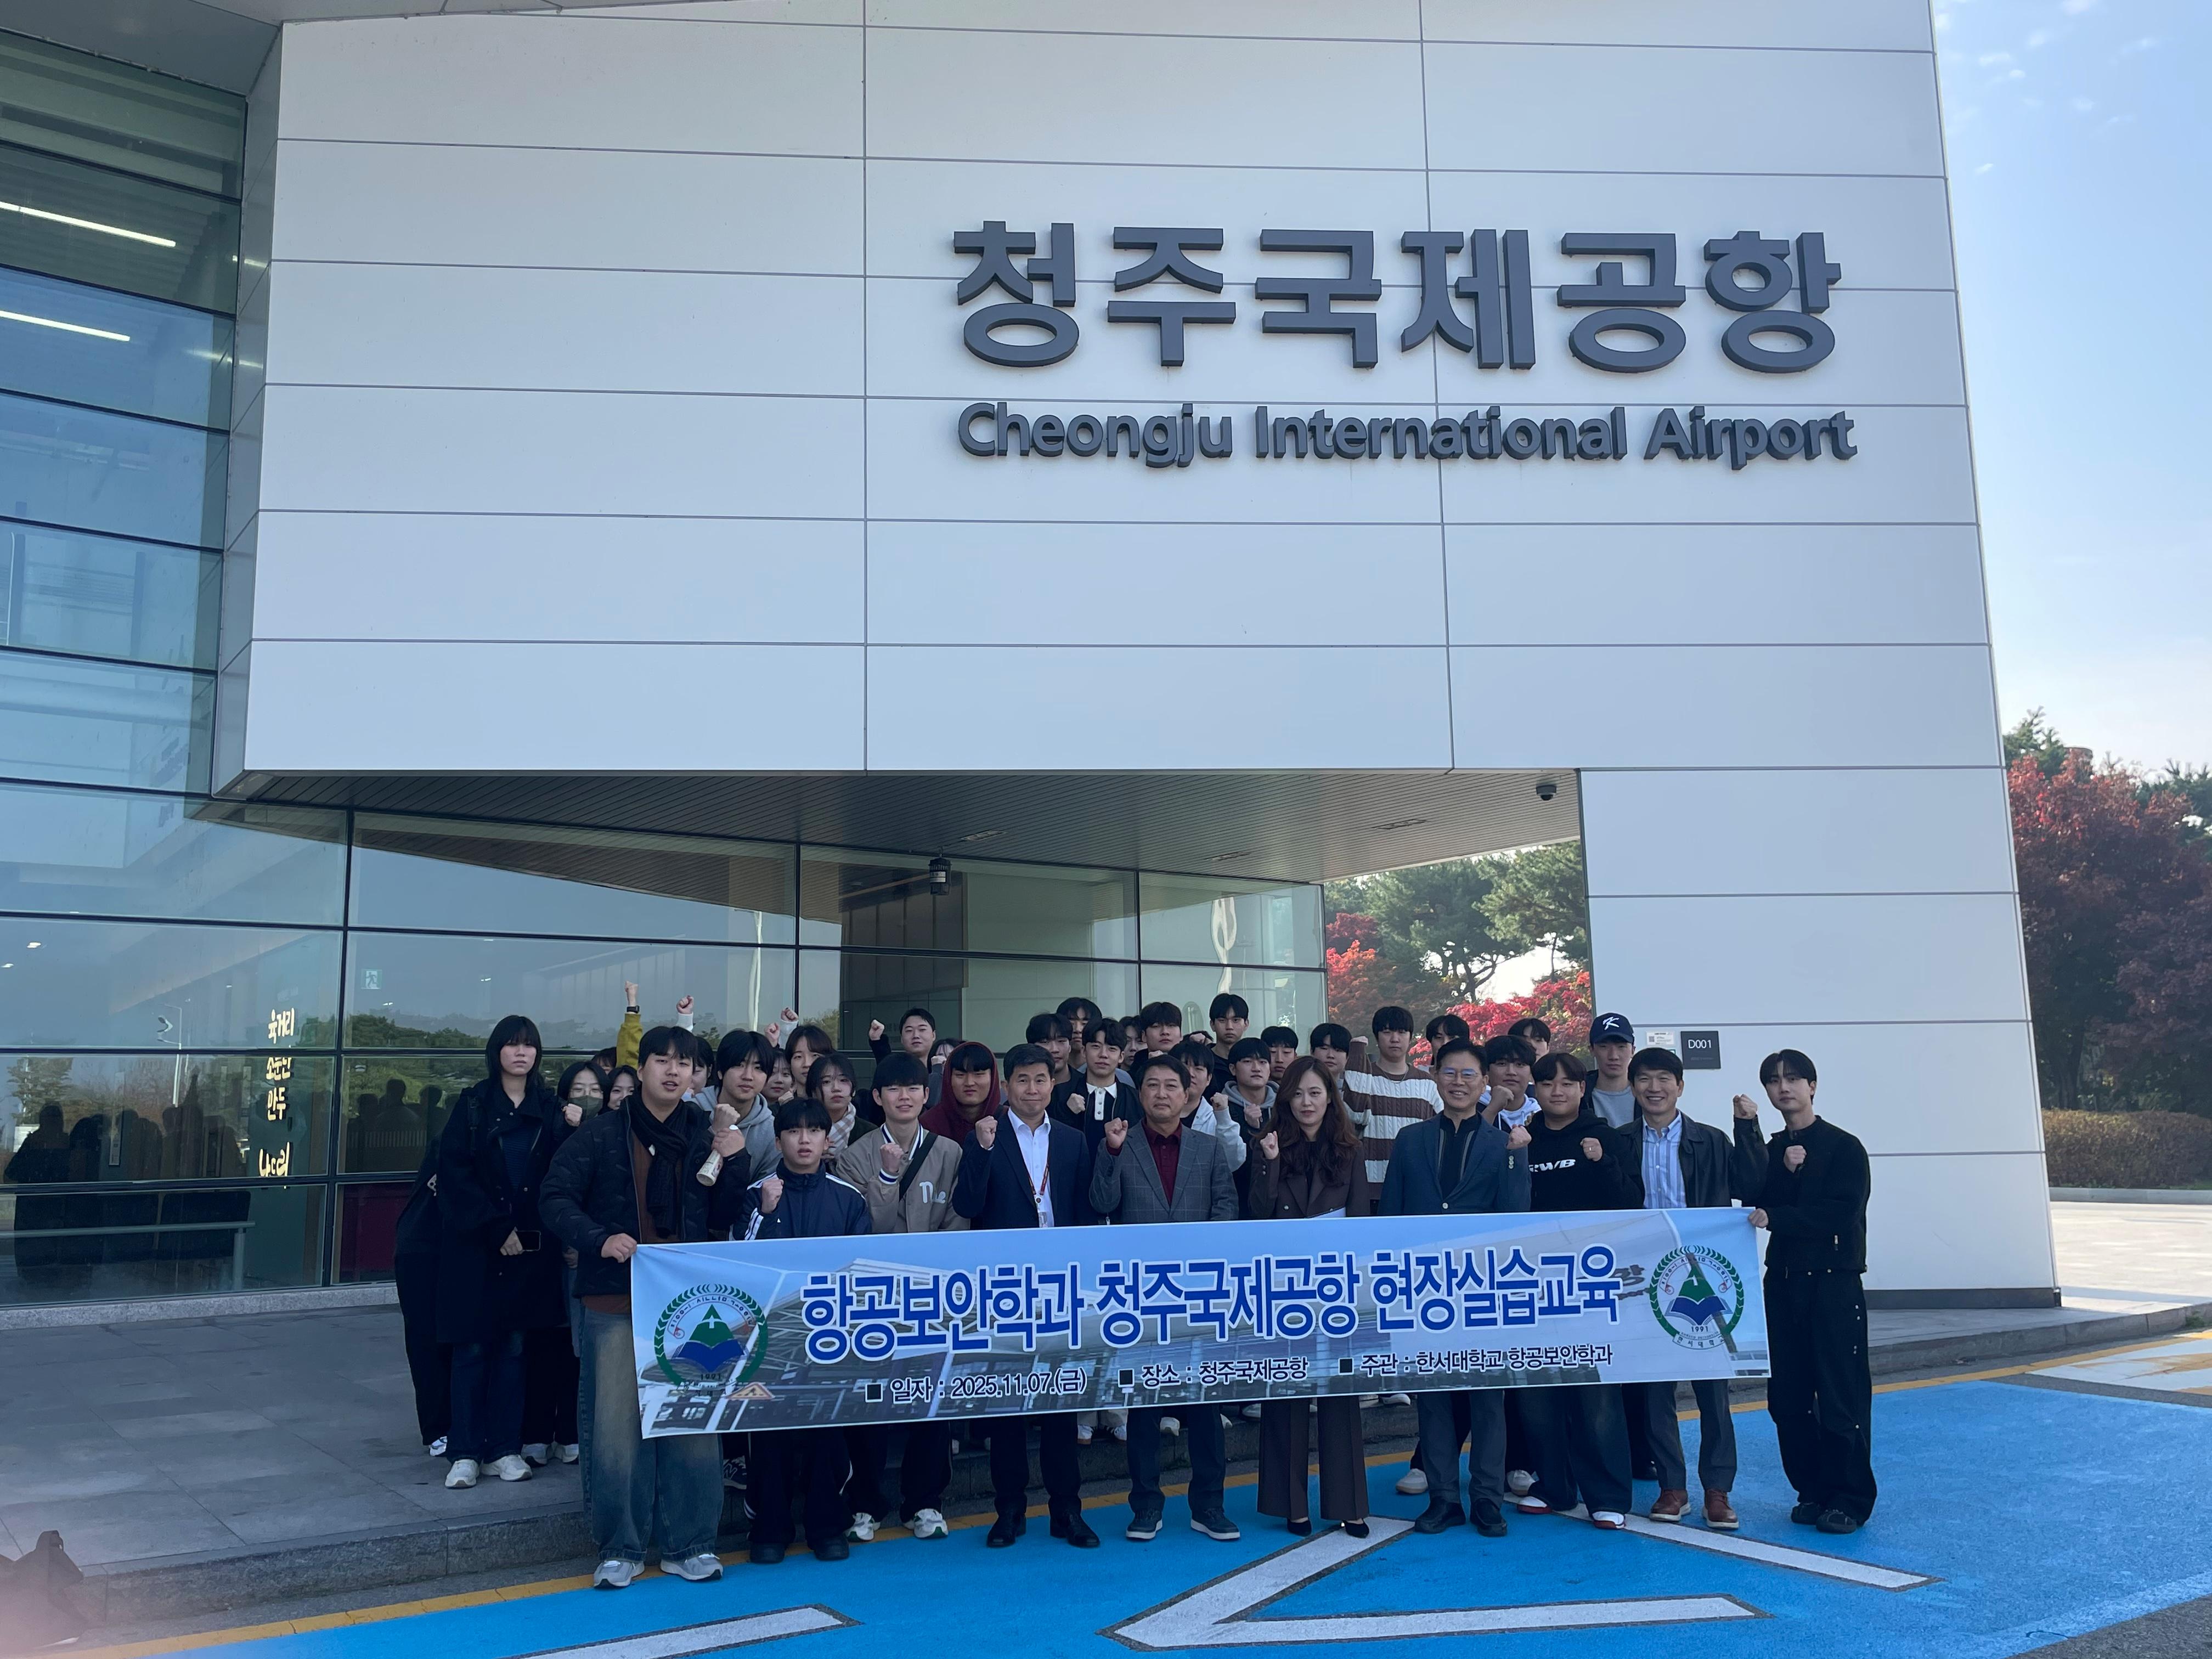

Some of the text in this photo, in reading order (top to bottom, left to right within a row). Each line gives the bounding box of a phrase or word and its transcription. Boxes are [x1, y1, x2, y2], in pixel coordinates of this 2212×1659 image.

[953, 221, 1841, 374] 청주국제공항
[957, 402, 1859, 471] Cheongju International Airport
[268, 1007, 295, 1044] 육거리
[1688, 1039, 1712, 1049] D001
[267, 1087, 286, 1121] 만두
[802, 1244, 1622, 1364] 항공보안학과 청주국제공항 현장실습교육
[891, 1377, 932, 1403] 일자
[951, 1367, 1087, 1398] 2025.11.07.(금)
[1142, 1364, 1180, 1388] 장소
[1199, 1356, 1308, 1384] 청주국제공항
[1361, 1352, 1399, 1376] 주관
[1415, 1348, 1504, 1374] 한서대학교
[1508, 1343, 1613, 1369] 항공보안학과
